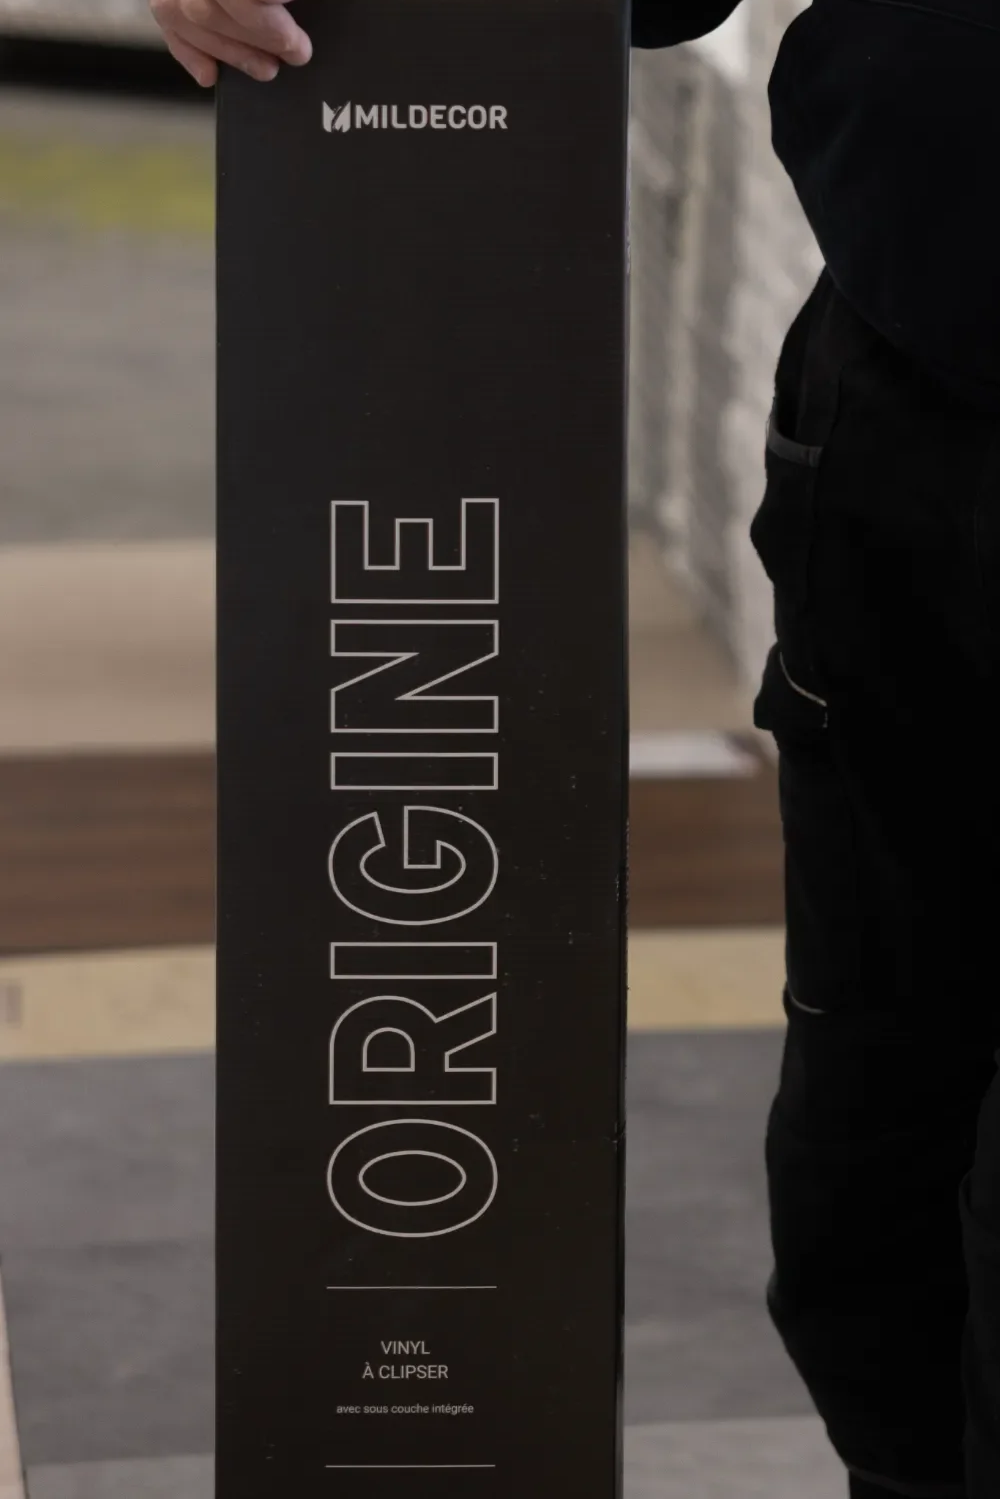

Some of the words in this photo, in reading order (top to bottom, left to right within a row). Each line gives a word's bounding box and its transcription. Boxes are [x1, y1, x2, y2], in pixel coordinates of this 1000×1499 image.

[354, 104, 510, 131] MILDECOR
[326, 496, 501, 1239] ORIGINE
[380, 1340, 431, 1355] VINYL
[362, 1361, 374, 1380] À
[378, 1364, 449, 1380] CLIPSER
[336, 1404, 361, 1414] avec
[363, 1404, 389, 1414] sous
[390, 1402, 429, 1414] couche
[432, 1402, 475, 1416] intégrée
